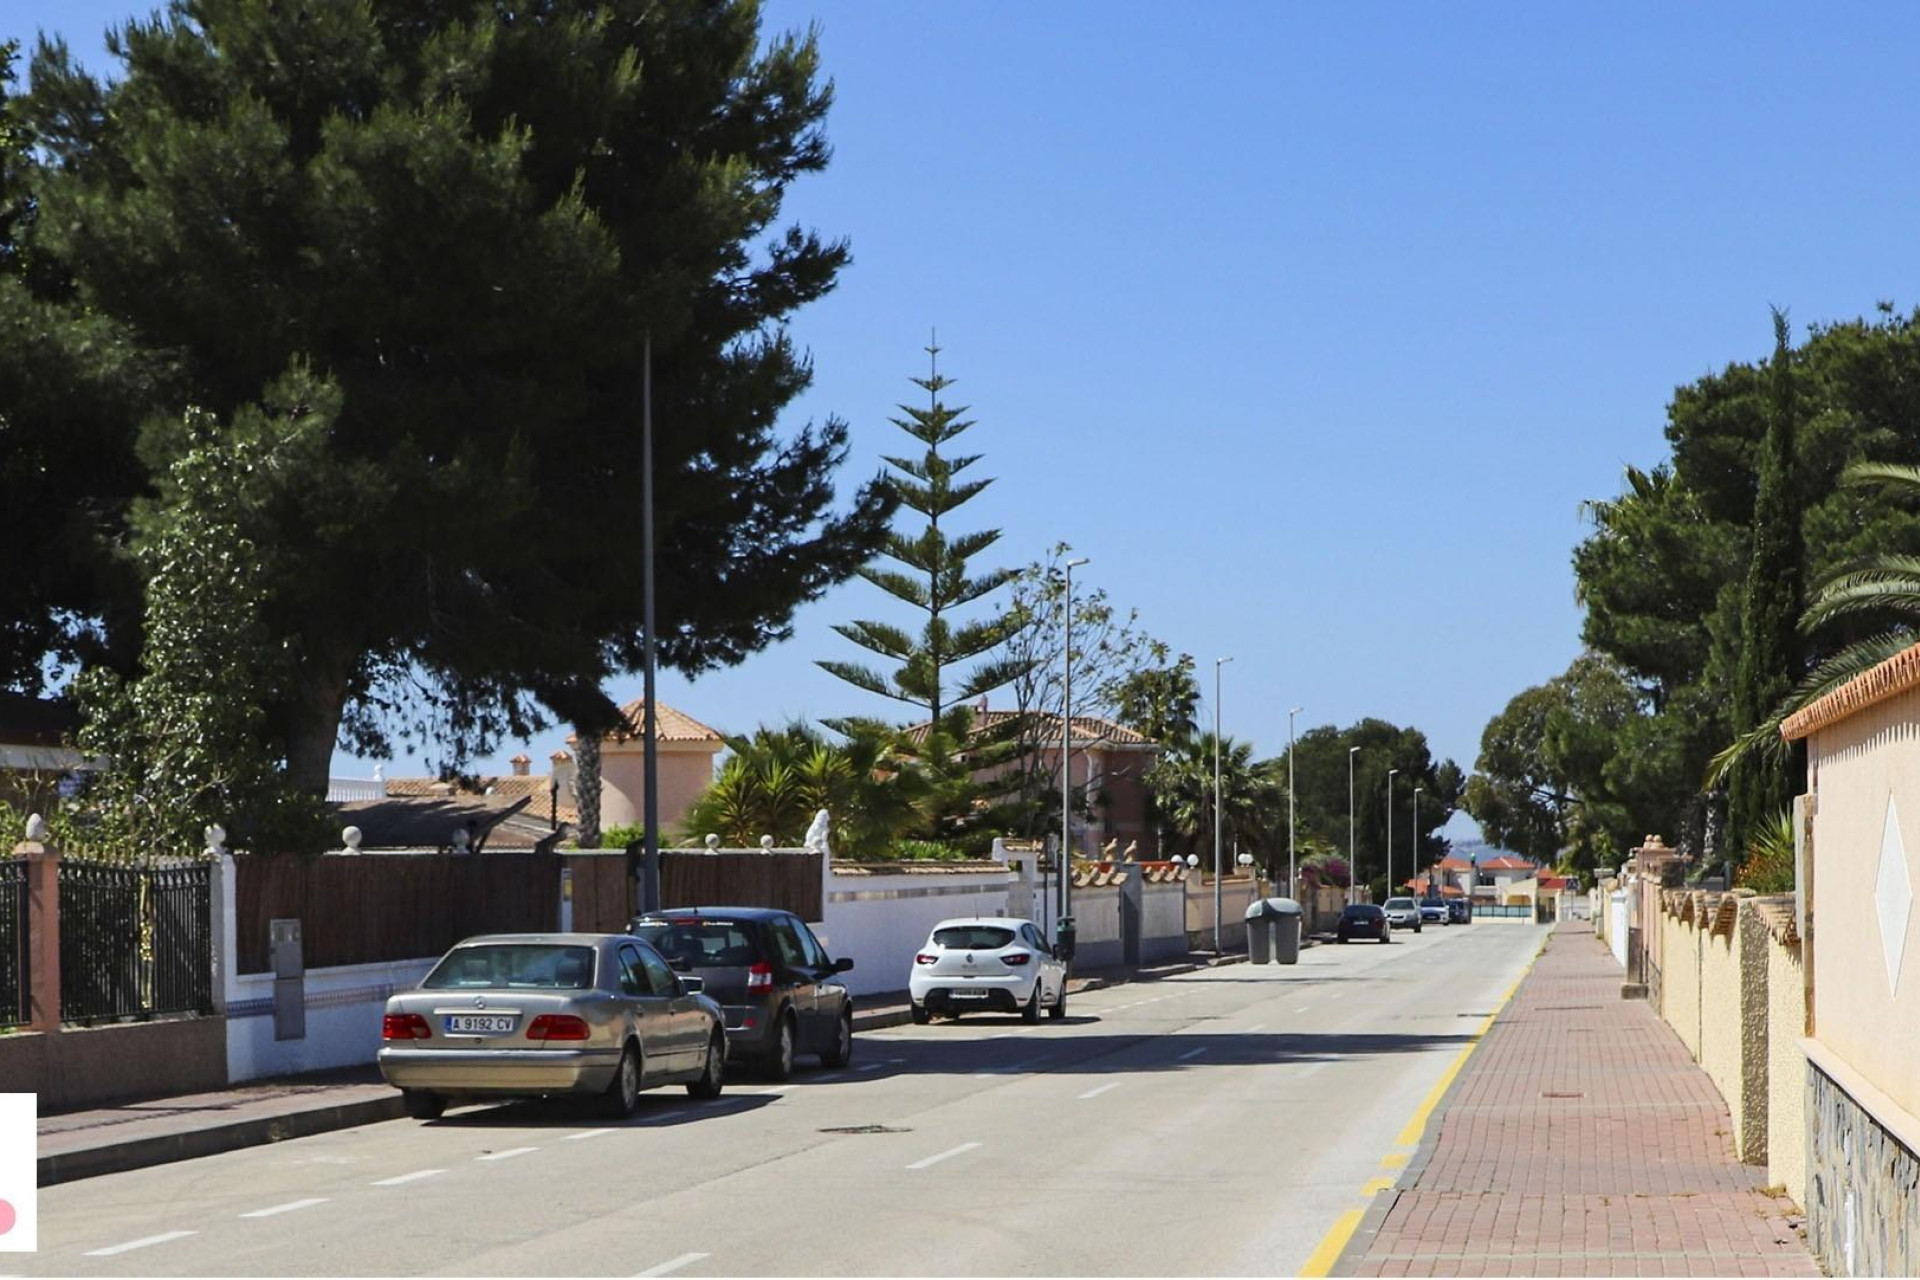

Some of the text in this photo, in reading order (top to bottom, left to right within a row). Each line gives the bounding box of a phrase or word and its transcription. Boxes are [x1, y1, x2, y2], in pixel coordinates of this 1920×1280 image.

[453, 1017, 512, 1030] A 9192 CV
